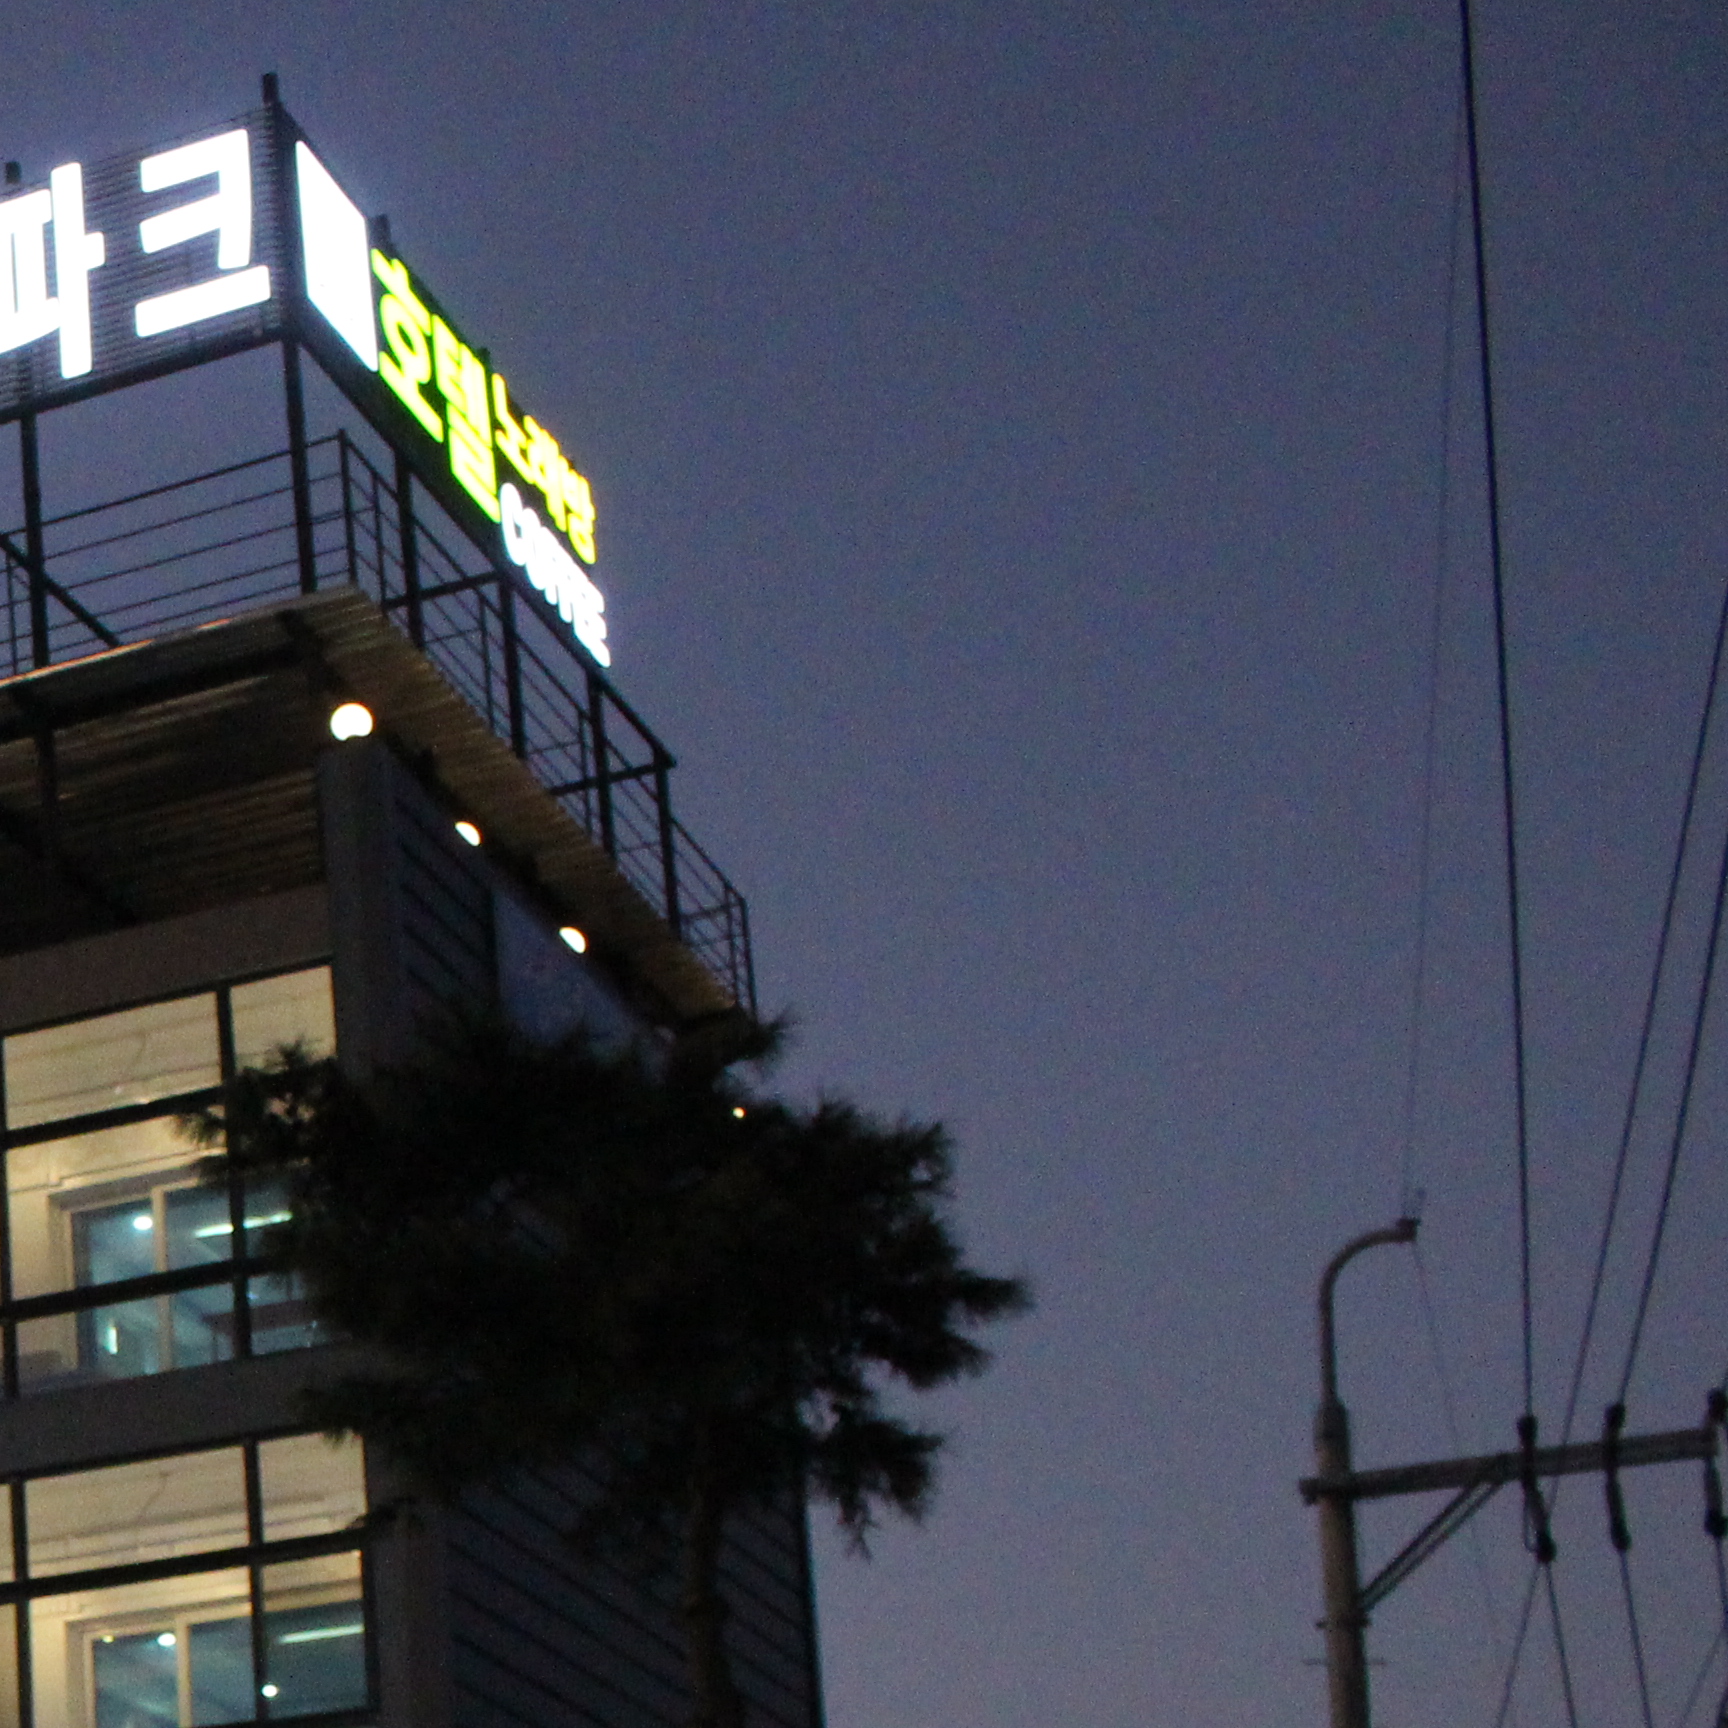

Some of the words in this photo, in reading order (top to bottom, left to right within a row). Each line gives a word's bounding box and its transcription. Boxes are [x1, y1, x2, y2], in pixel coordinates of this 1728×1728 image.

[370, 248, 502, 524] 호텔
[490, 373, 597, 565] 노래방
[499, 481, 611, 668] COFFEE
